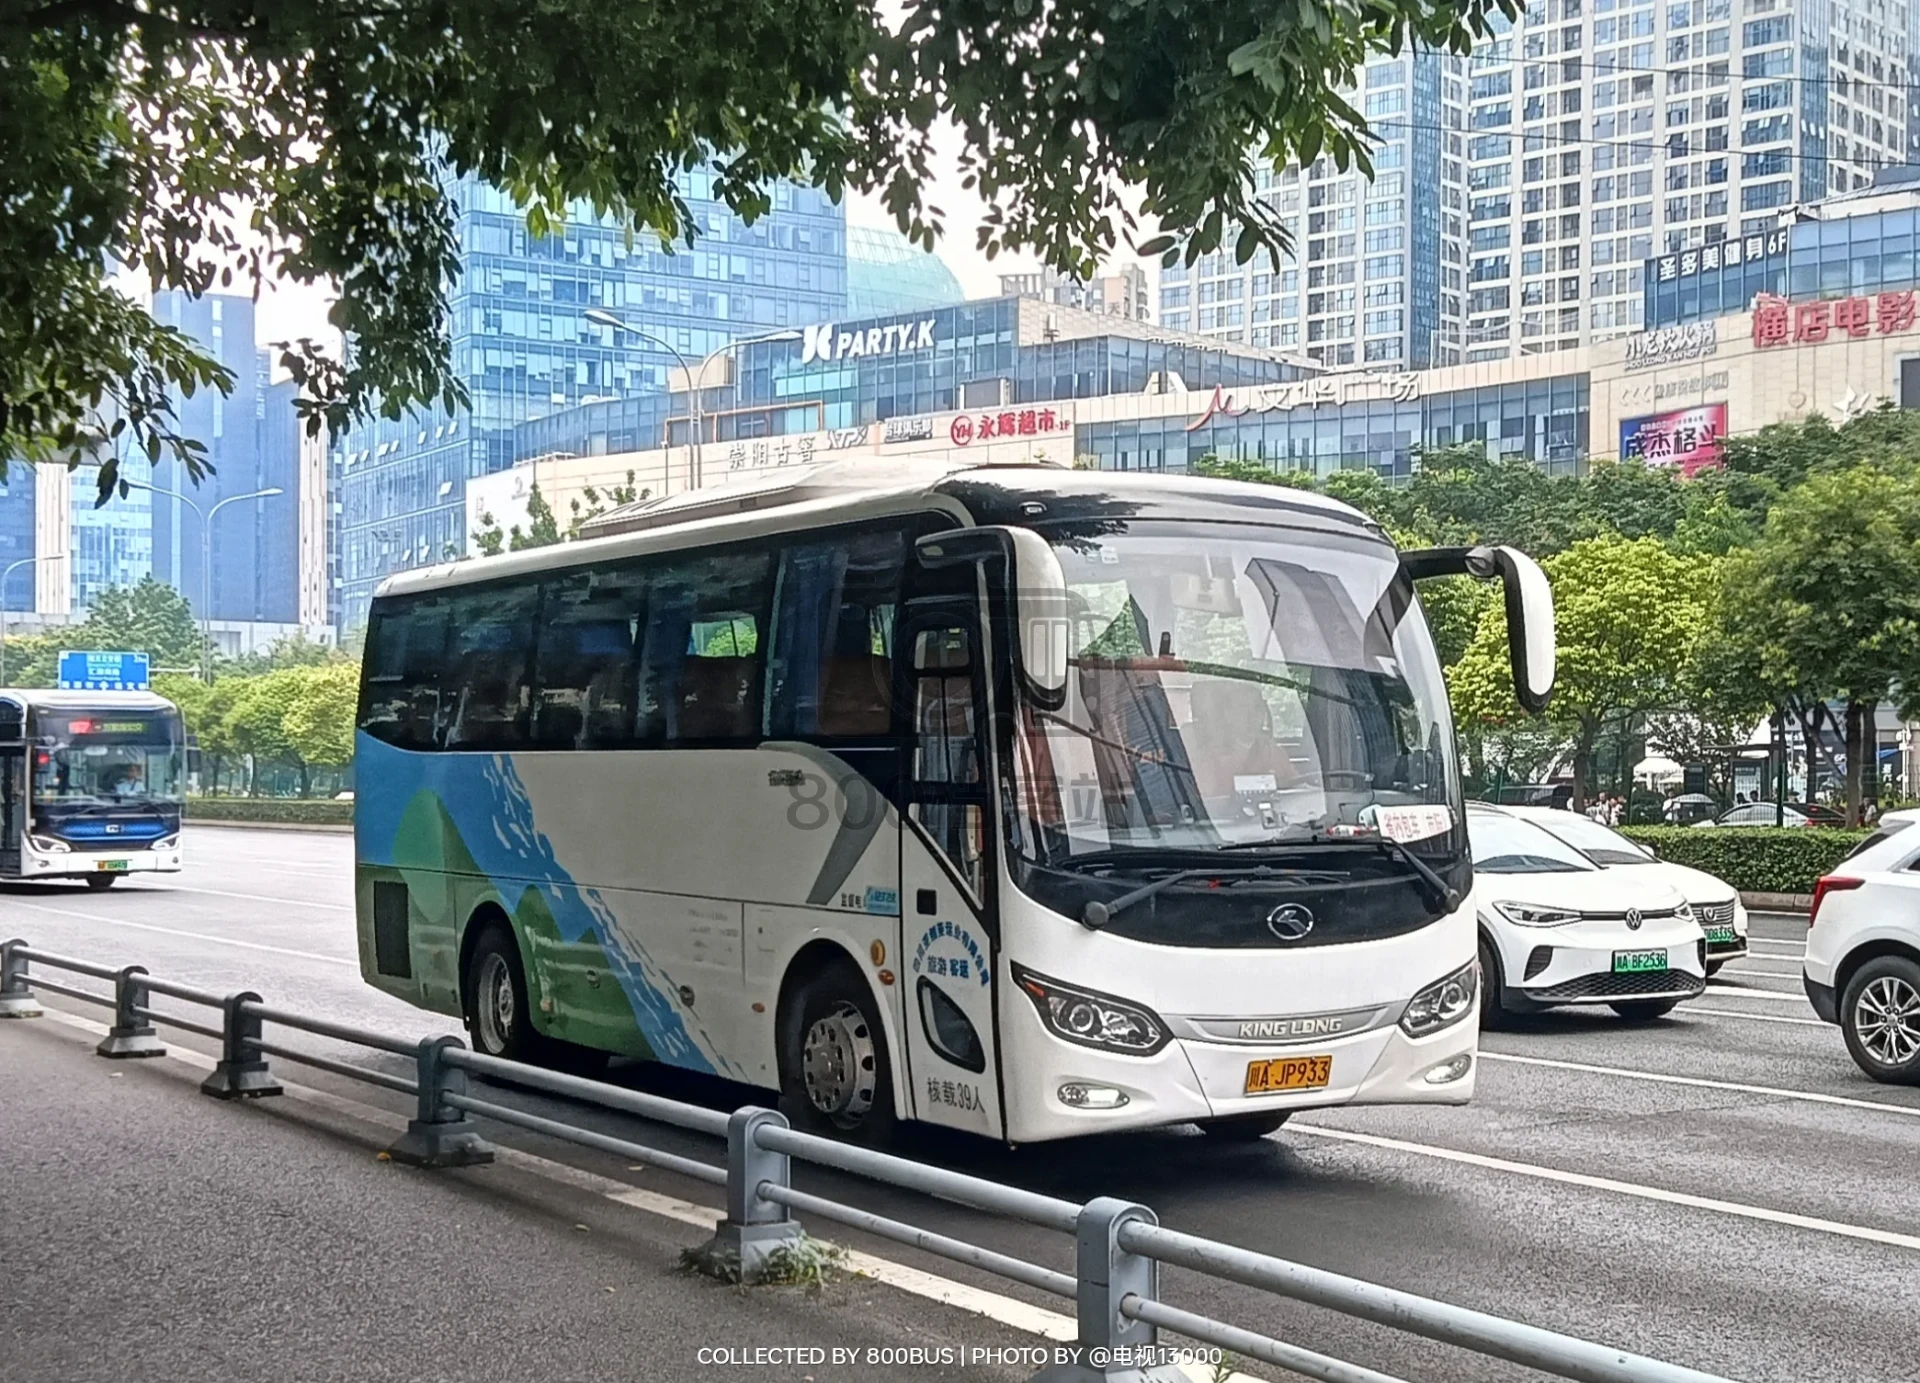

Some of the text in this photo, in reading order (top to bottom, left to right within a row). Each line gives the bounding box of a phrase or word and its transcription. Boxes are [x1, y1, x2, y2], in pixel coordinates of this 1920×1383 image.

[836, 319, 936, 359] PARTY.K
[1751, 290, 1915, 348] 横店电影
[1255, 371, 1420, 413] 文华广场
[977, 409, 1056, 439] 永辉超市
[1239, 1018, 1343, 1038] KING LONG
